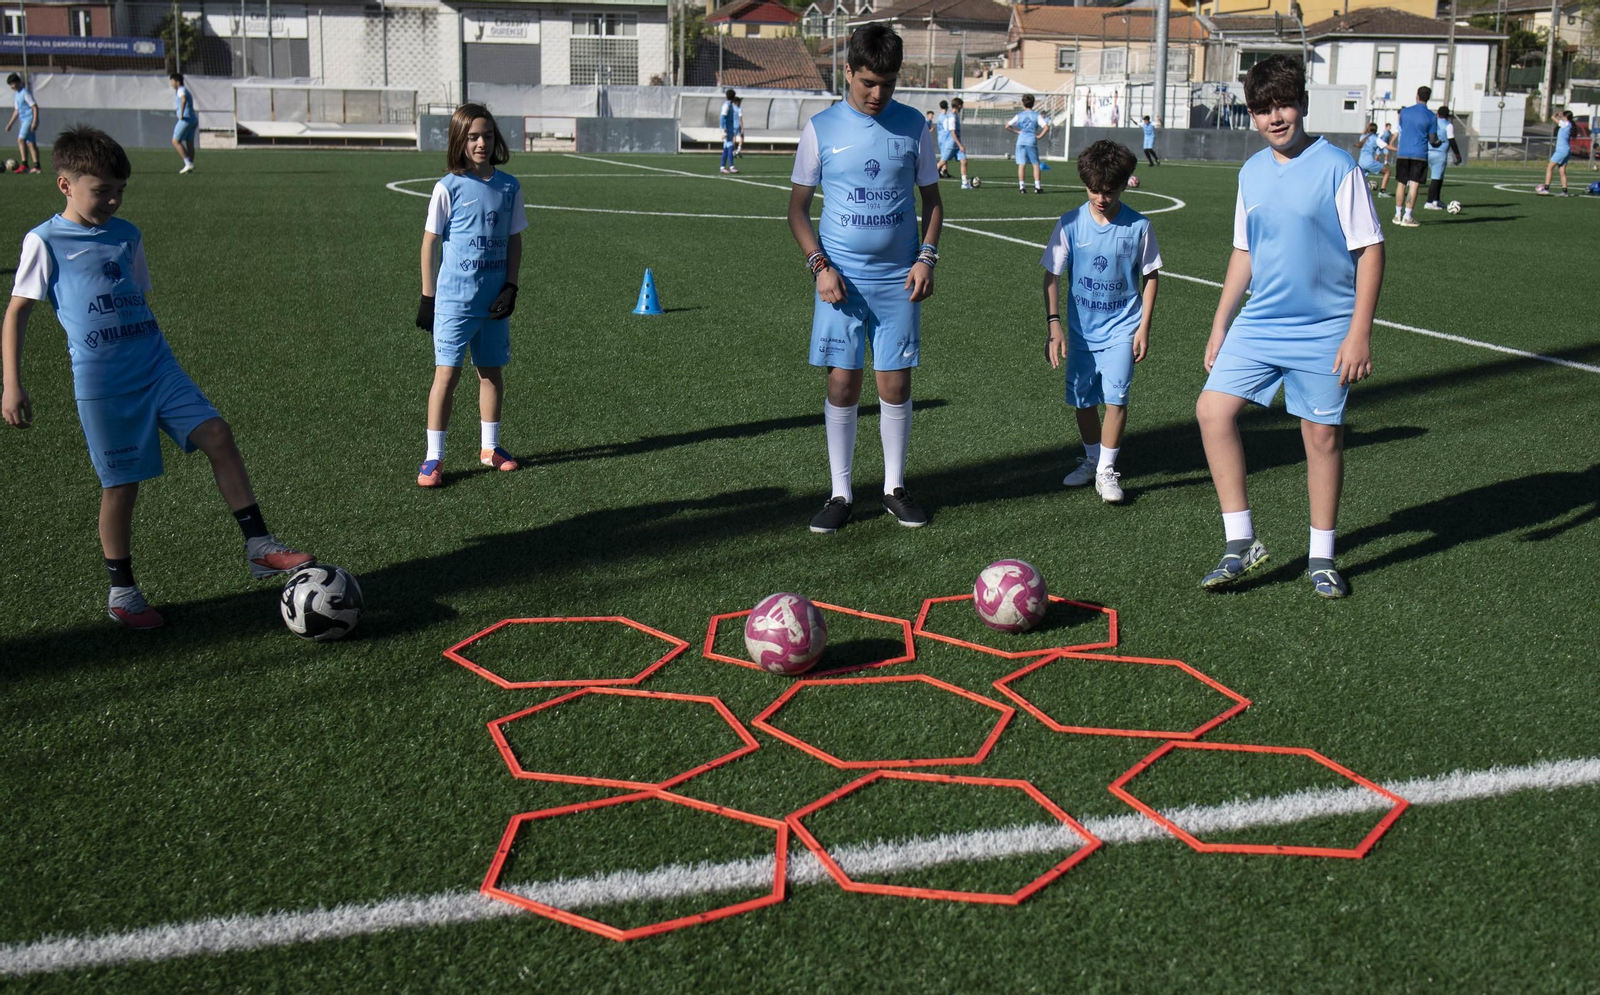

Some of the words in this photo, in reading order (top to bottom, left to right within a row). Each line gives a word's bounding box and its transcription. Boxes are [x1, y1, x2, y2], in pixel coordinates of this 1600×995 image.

[2, 40, 41, 48] MUNIIPAL
[52, 41, 86, 49] DEPORTES
[97, 42, 128, 50] OURENSE
[846, 187, 899, 203] ALONSO
[1078, 276, 1123, 291] ALONSO
[1081, 297, 1128, 311] VILACASTRO
[99, 319, 159, 342] VILACASTRO
